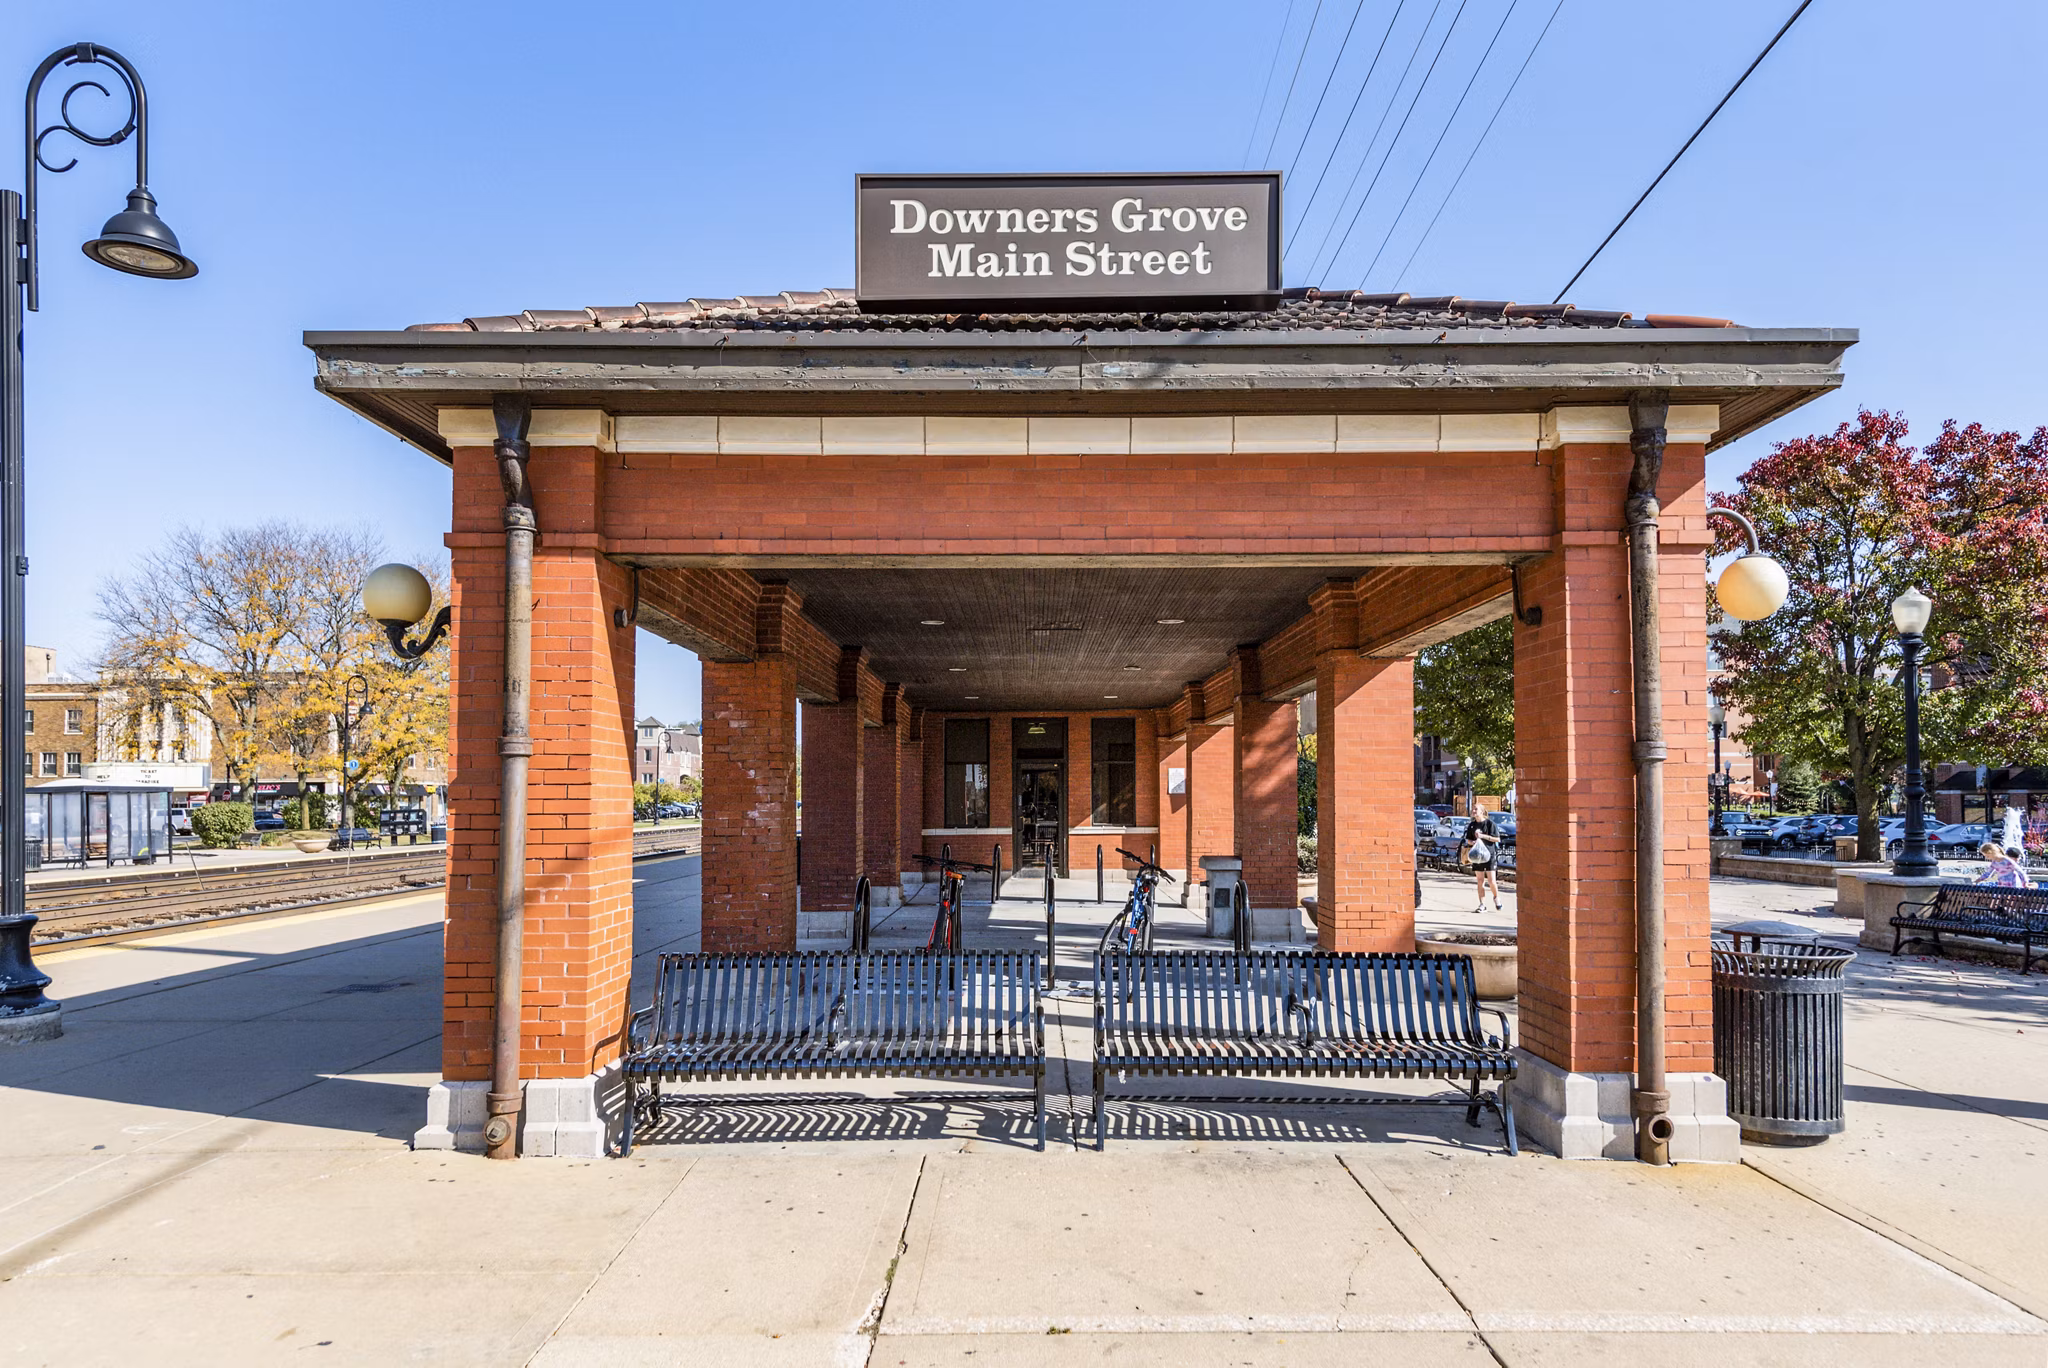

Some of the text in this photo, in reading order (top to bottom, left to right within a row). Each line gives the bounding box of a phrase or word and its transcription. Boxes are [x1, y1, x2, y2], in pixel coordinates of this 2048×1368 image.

[890, 197, 1248, 235] Downers Grove
[927, 240, 1213, 278] Main Street
